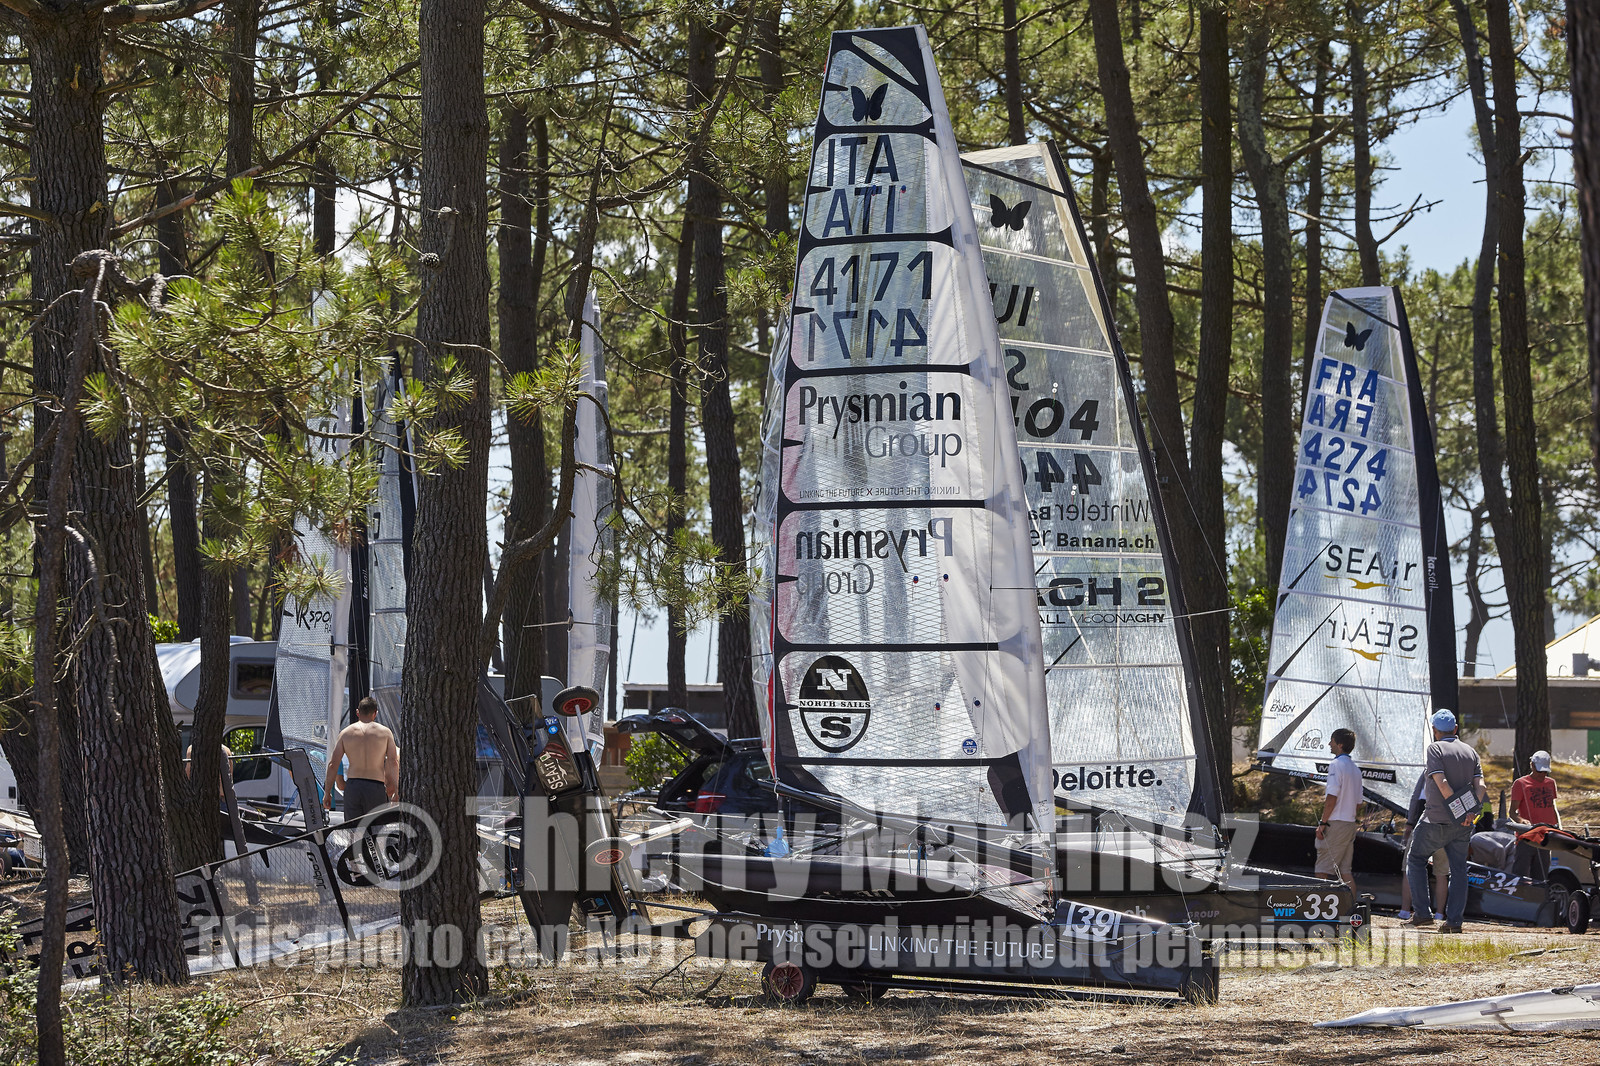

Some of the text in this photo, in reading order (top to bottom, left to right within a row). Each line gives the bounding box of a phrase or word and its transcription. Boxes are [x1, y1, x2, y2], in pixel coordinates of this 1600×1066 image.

[826, 134, 900, 187] ITA
[809, 251, 933, 305] 4171
[1315, 358, 1378, 403] FRA
[798, 381, 961, 439] Prysmian
[864, 425, 963, 468] Group
[1303, 432, 1387, 481] 4274
[800, 489, 824, 499] LINKING
[825, 489, 838, 498] THE
[838, 488, 864, 497] FUTURE
[1056, 532, 1154, 549] Banana.ch
[1137, 576, 1166, 606] 2
[1071, 613, 1165, 624] McCONAGHY
[816, 669, 852, 691] N
[799, 700, 836, 708] NORTH
[820, 716, 851, 739] S
[1489, 872, 1521, 896] 34
[1273, 907, 1296, 917] WIP
[1303, 893, 1339, 920] 33
[1076, 906, 1112, 938] 39
[869, 935, 1055, 959] LINKING THE FUTURE
